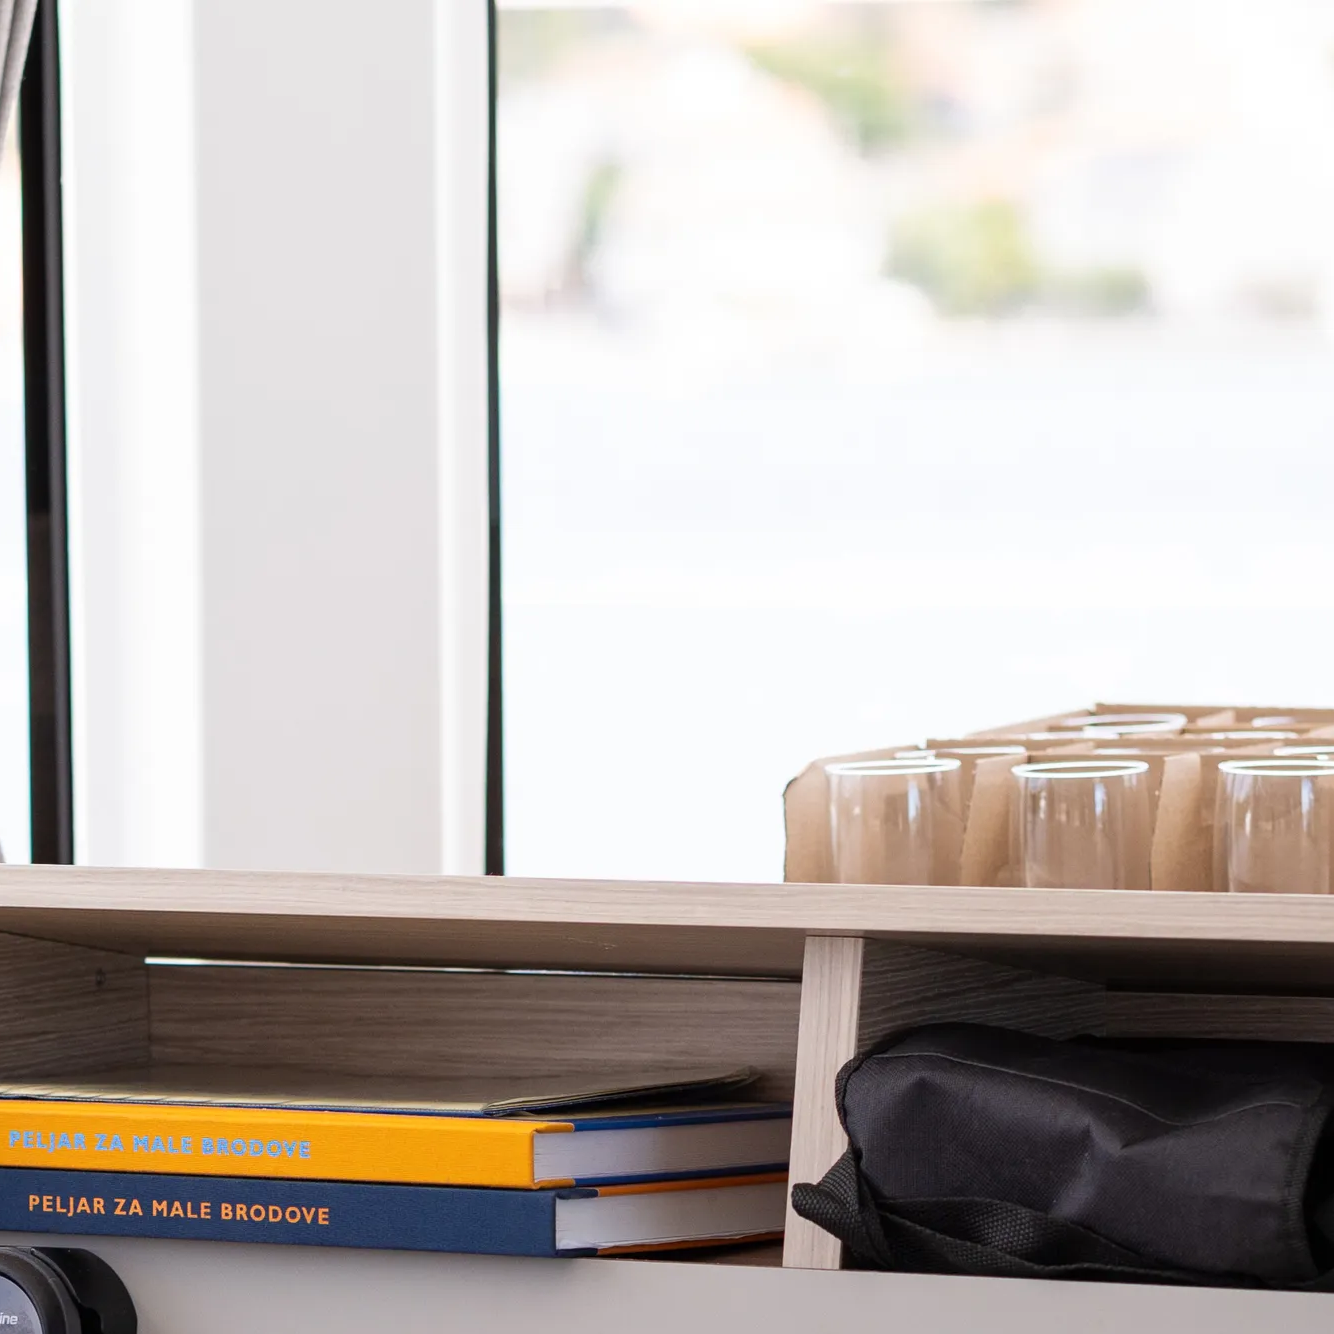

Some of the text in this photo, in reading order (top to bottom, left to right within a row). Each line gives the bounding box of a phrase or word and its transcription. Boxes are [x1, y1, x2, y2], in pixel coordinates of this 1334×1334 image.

[9, 1131, 86, 1153] PELJAR
[95, 1134, 125, 1152] ZA
[133, 1136, 193, 1155] MALE
[201, 1138, 312, 1160] BRODOVE
[28, 1194, 105, 1217] PELJAR
[113, 1198, 143, 1217] ZA
[152, 1199, 211, 1220] MALE
[220, 1203, 331, 1226] BRODOVE
